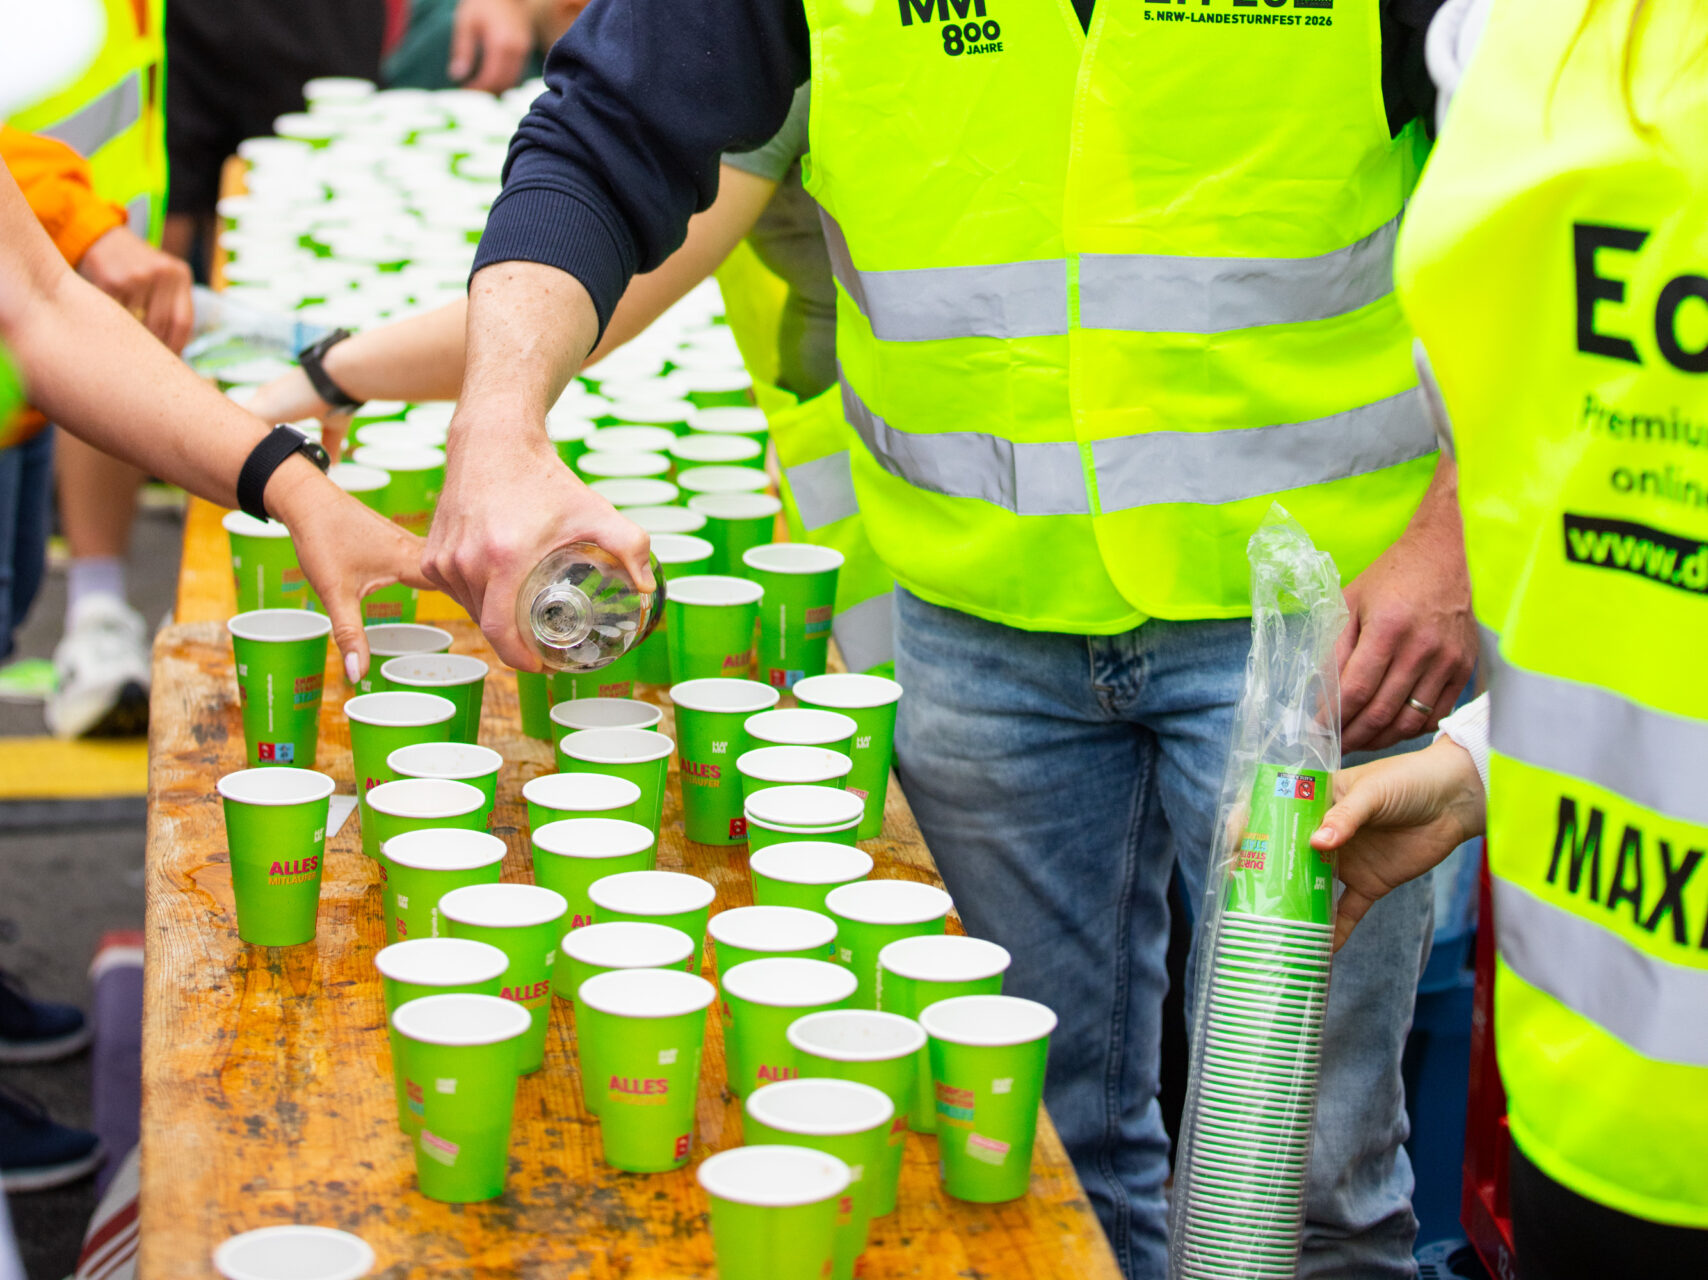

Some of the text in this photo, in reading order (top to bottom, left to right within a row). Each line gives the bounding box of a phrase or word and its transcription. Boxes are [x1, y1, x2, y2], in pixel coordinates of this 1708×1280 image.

[1143, 10, 1333, 27] 5. NRW-LANDESTURNFEST 2026
[941, 19, 1001, 56] 800
[966, 41, 1004, 55] JAHRE
[1611, 466, 1708, 506] onlin
[681, 757, 720, 779] ALLES
[269, 855, 318, 876] ALLES
[500, 980, 550, 1001] ALLES
[609, 1075, 669, 1095] ALLES
